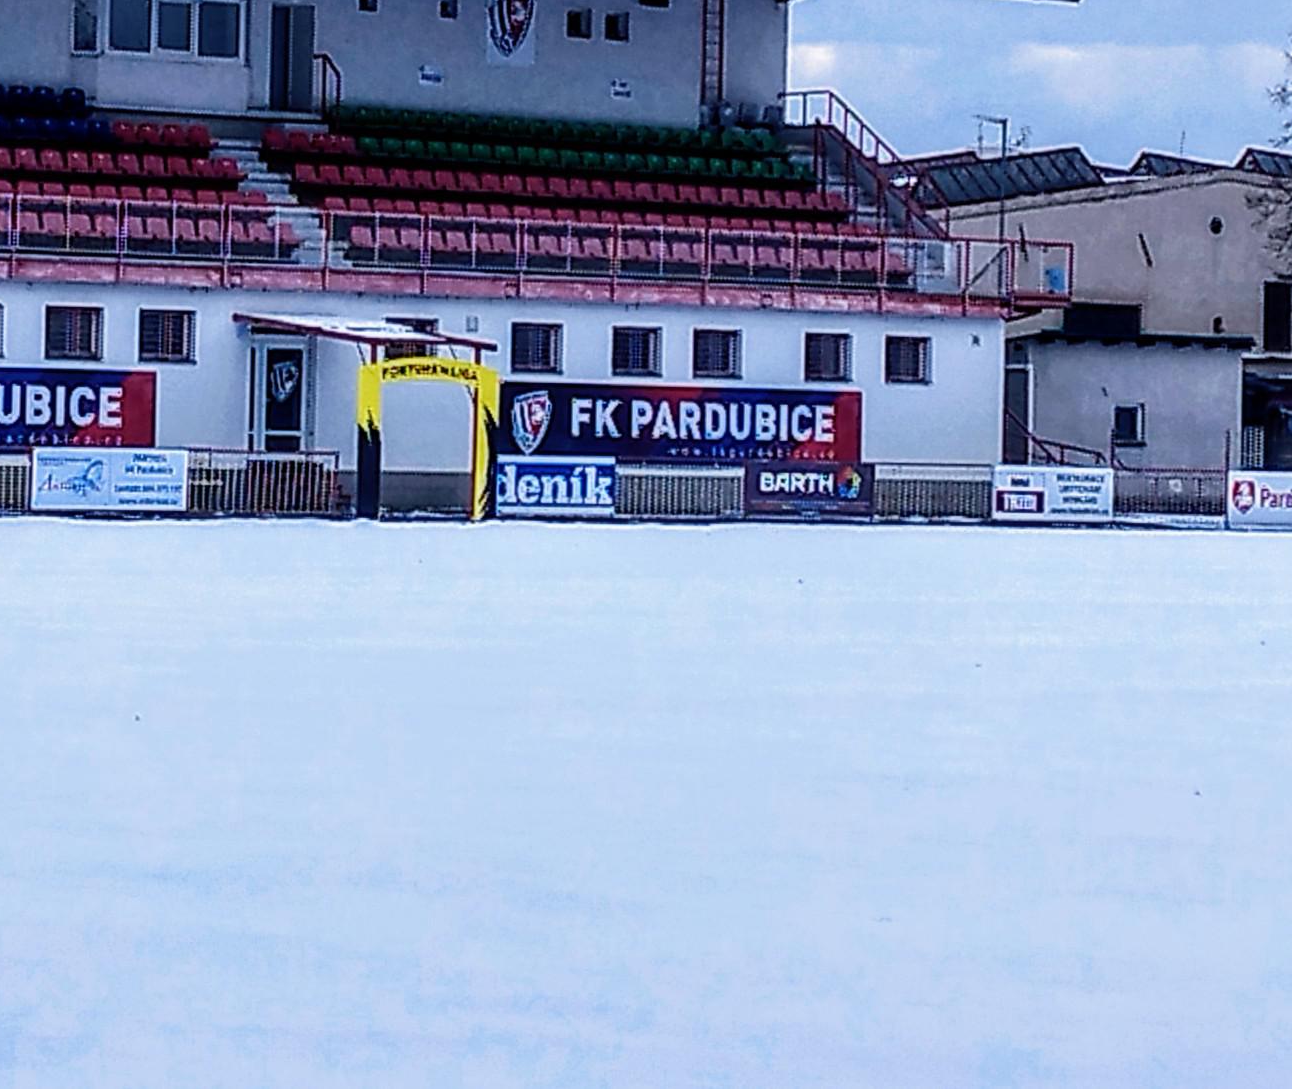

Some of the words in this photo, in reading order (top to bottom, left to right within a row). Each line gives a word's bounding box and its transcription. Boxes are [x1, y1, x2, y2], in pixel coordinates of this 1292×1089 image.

[572, 398, 622, 438] FK
[631, 399, 836, 443] PARDUBICE
[497, 465, 613, 505] deník
[760, 471, 834, 494] BARTH
